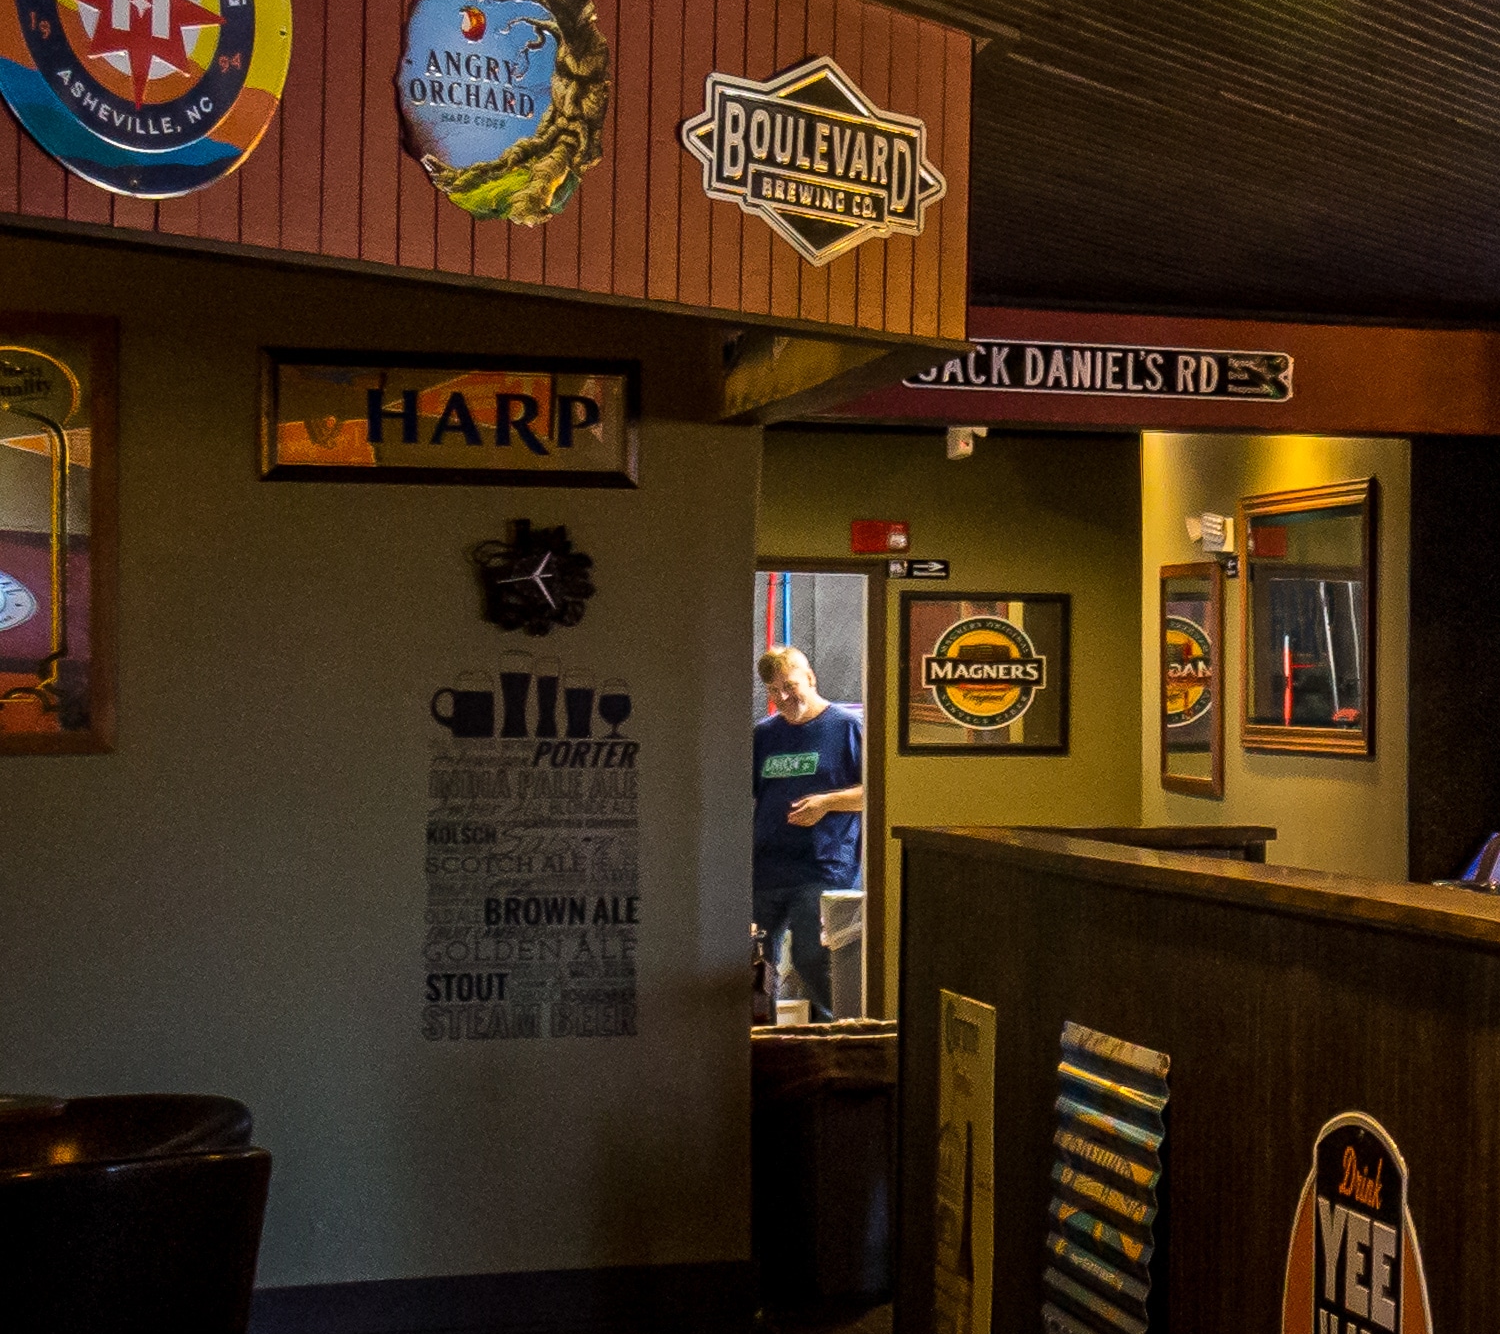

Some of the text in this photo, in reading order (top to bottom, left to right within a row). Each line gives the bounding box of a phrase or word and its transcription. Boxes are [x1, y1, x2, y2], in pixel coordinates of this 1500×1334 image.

[426, 49, 518, 85] ANGRY
[56, 68, 214, 135] ASHEVILLE, NC
[410, 78, 535, 117] ORCHARD
[724, 102, 911, 212] BOULEVARD
[762, 177, 877, 218] BREWING CO.
[1024, 347, 1165, 391] DANIEL'S
[1176, 355, 1219, 393] RD
[366, 388, 601, 456] HARP
[930, 661, 1039, 681] MAGNERS
[533, 741, 640, 767] PORTER
[484, 897, 640, 925] BROWN ALE
[423, 941, 561, 961] GOLDEN
[425, 973, 509, 1002] STOUT
[550, 1002, 637, 1037] BEER
[1338, 1146, 1384, 1210] Drink
